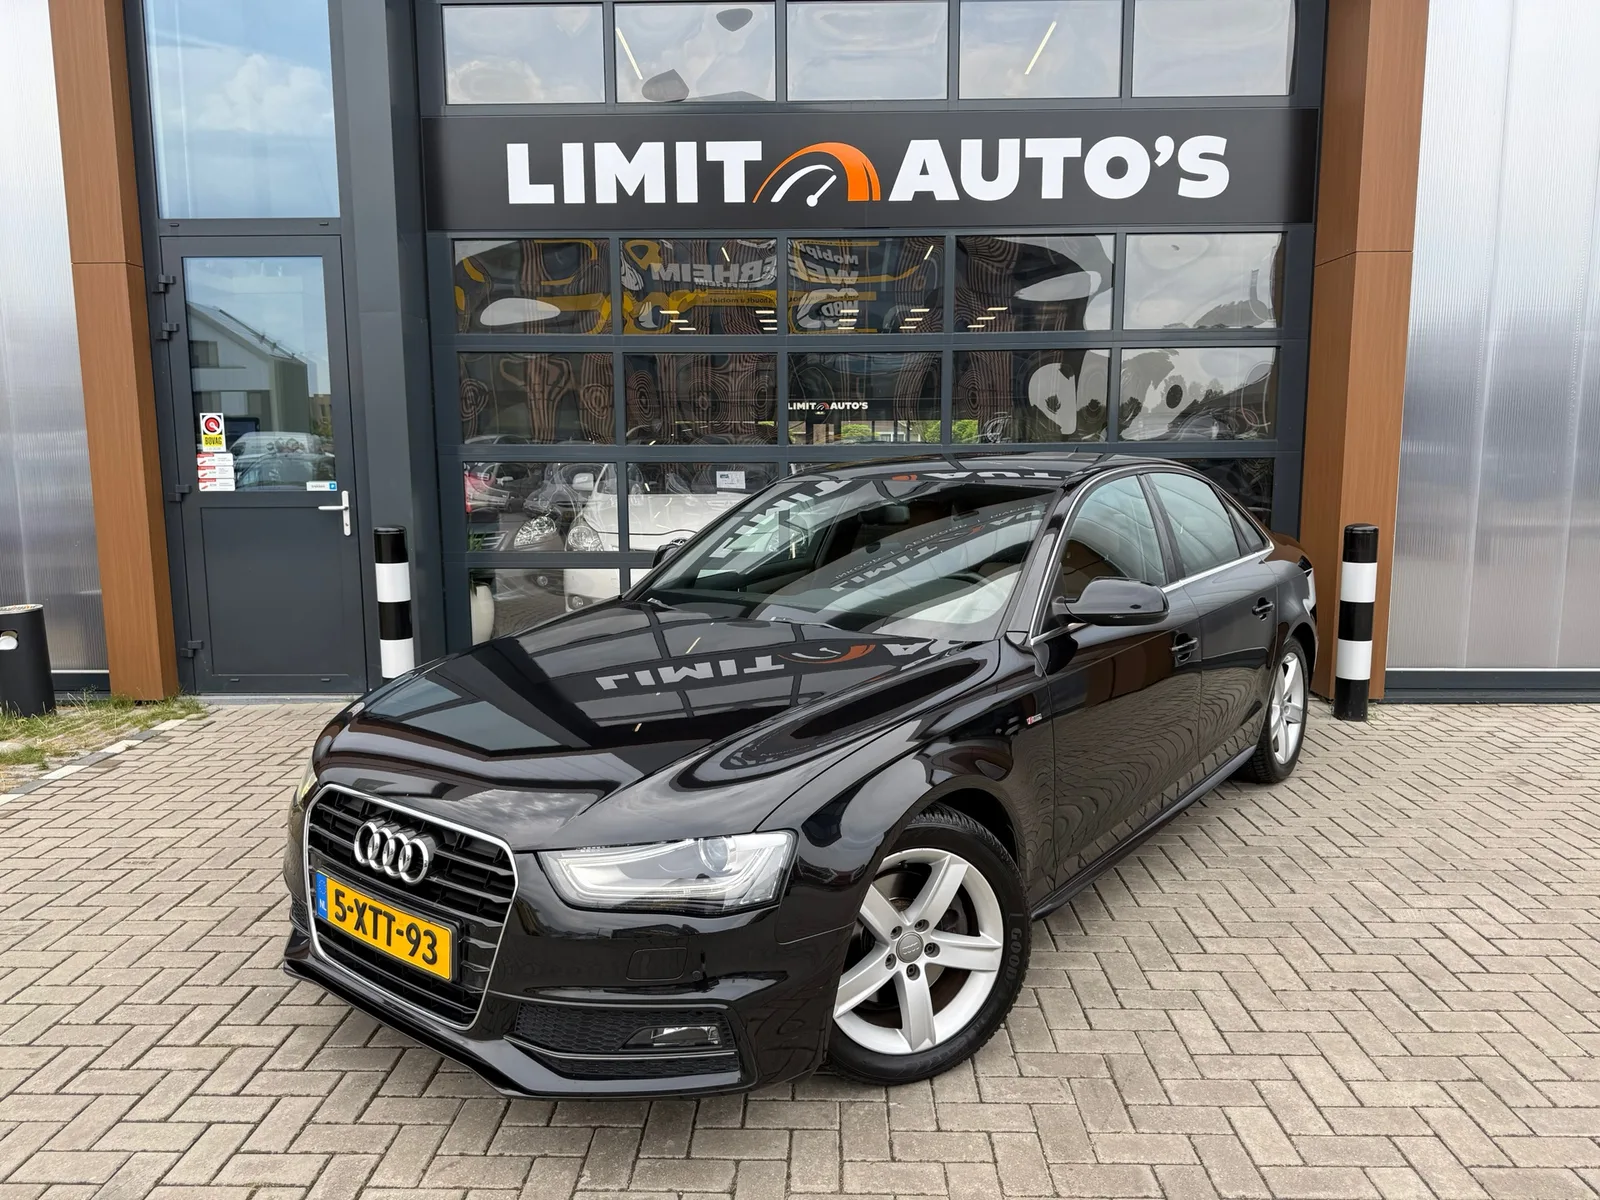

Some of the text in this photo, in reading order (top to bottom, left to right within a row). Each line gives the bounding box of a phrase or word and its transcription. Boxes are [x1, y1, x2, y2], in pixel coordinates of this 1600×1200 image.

[506, 134, 1230, 204] LIMIT AUTO'S
[788, 402, 815, 410] LIMIT
[319, 899, 327, 911] NL
[334, 888, 438, 966] 5-XTT-93
